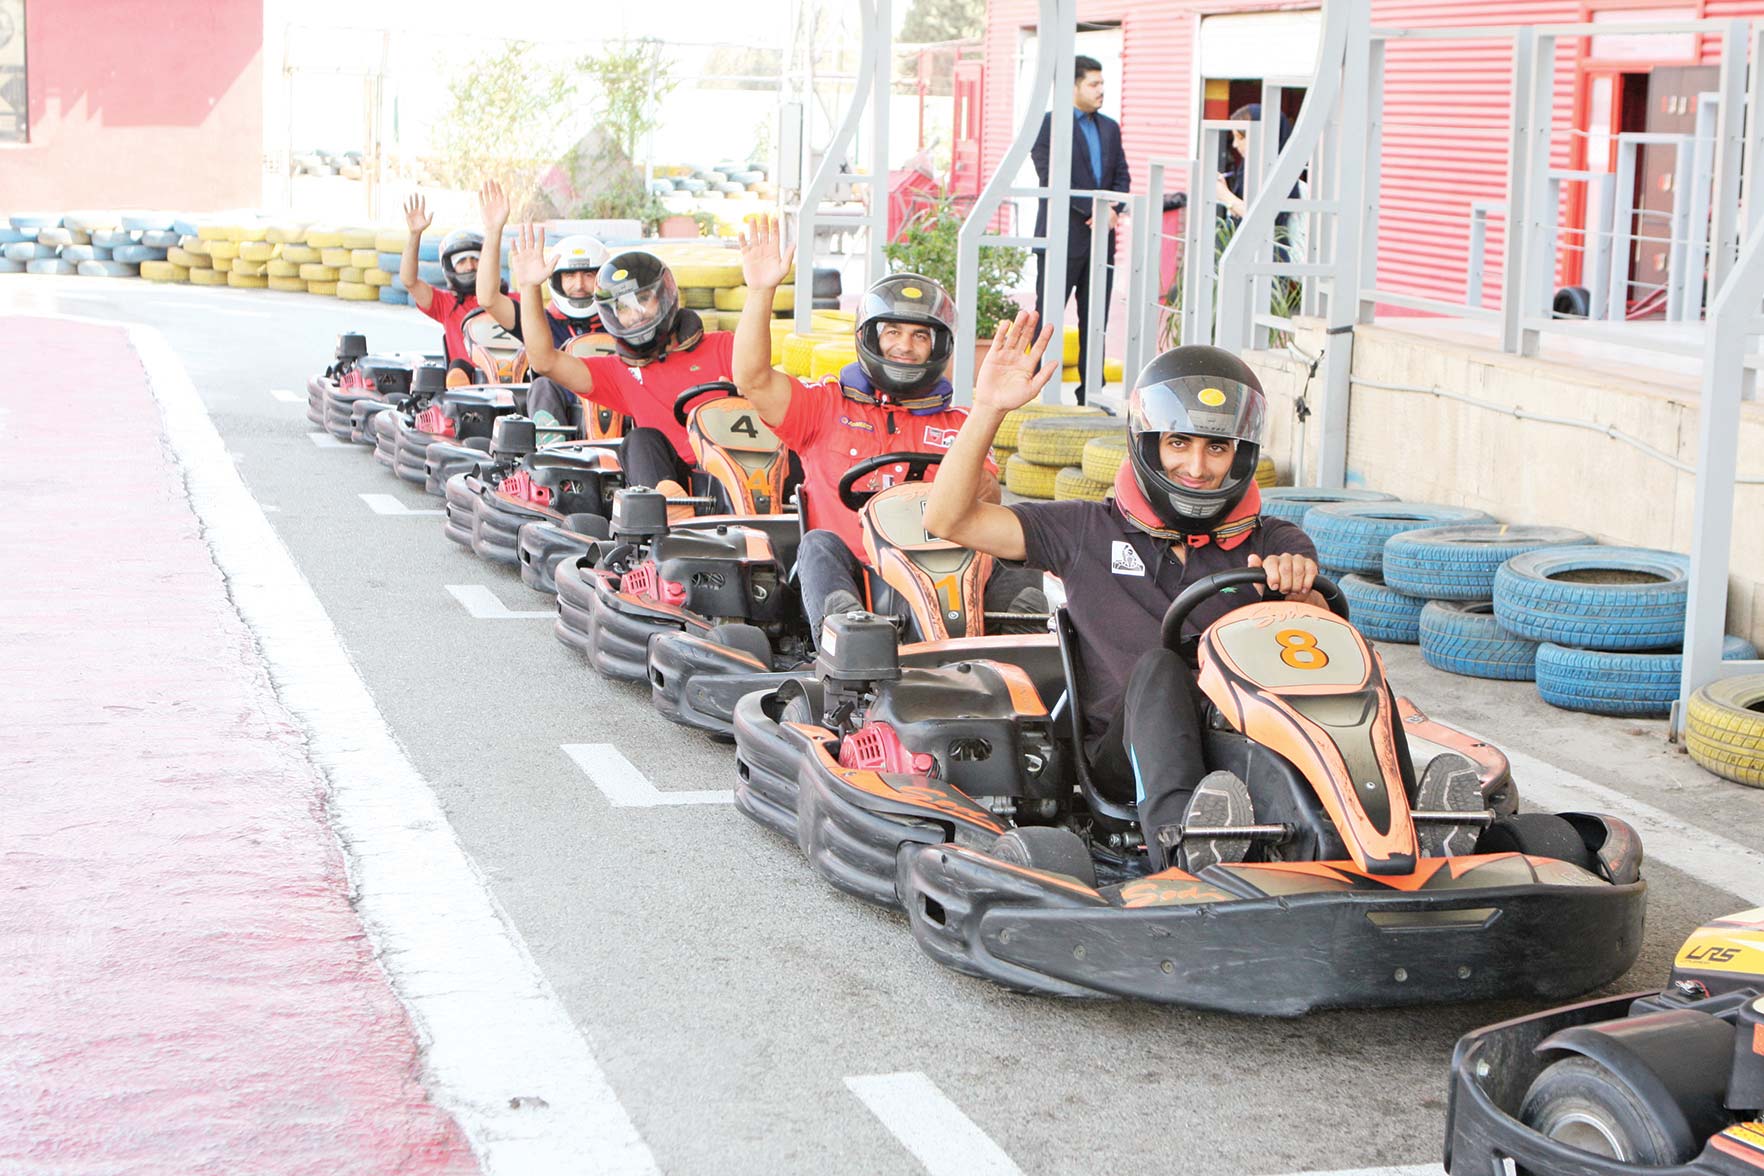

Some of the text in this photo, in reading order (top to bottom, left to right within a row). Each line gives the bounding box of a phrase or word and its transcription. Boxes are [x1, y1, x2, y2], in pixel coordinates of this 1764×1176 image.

[730, 415, 758, 438] 4
[746, 468, 771, 496] 4
[935, 574, 960, 611] 1
[1275, 629, 1330, 670] 8
[1685, 945, 1742, 962] LRS
